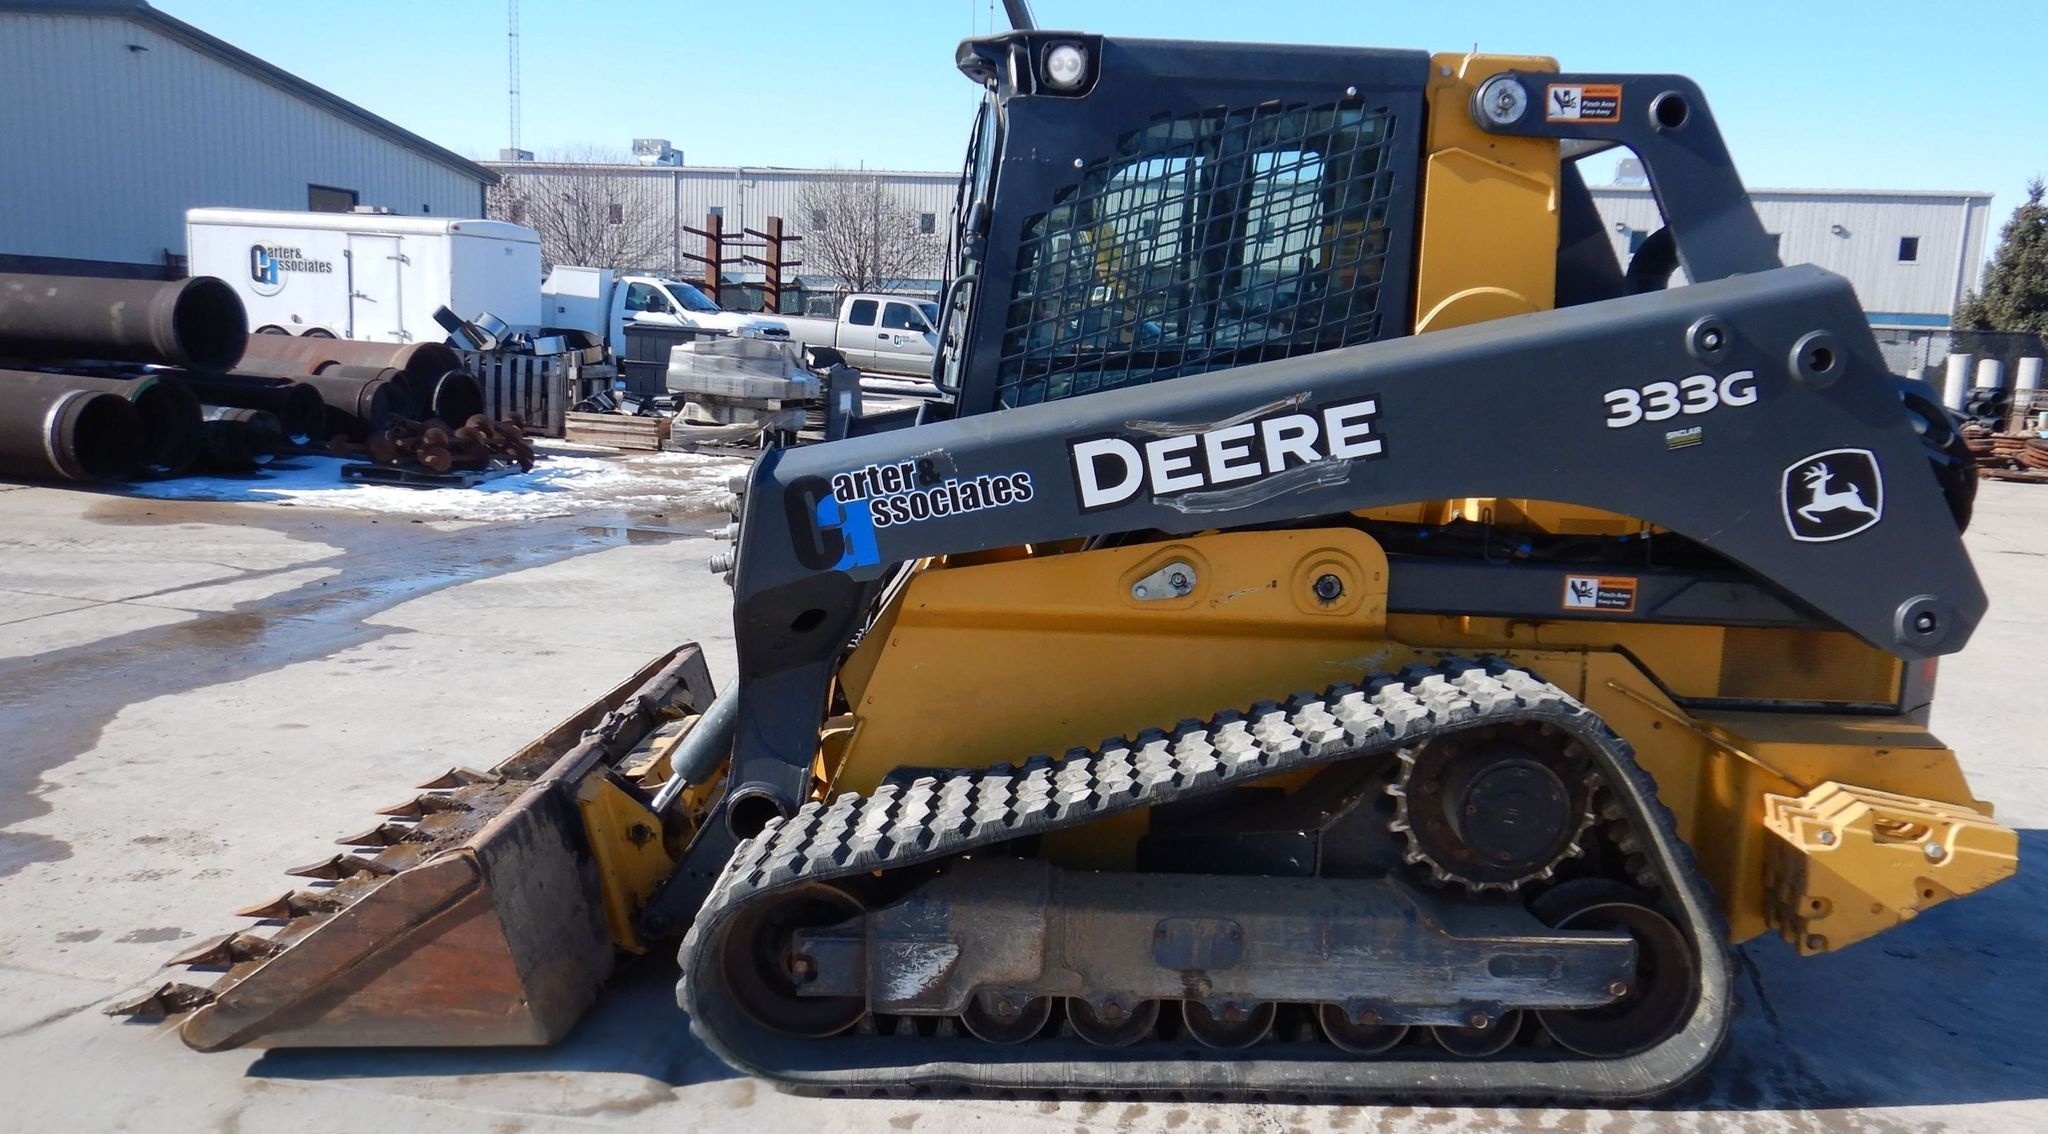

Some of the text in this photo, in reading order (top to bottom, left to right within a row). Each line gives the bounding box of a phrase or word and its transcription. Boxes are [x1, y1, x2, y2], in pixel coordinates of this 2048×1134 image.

[1604, 370, 1757, 428] 333G
[1073, 399, 1382, 510] DEERE
[1665, 426, 1702, 440] SINCLAIR
